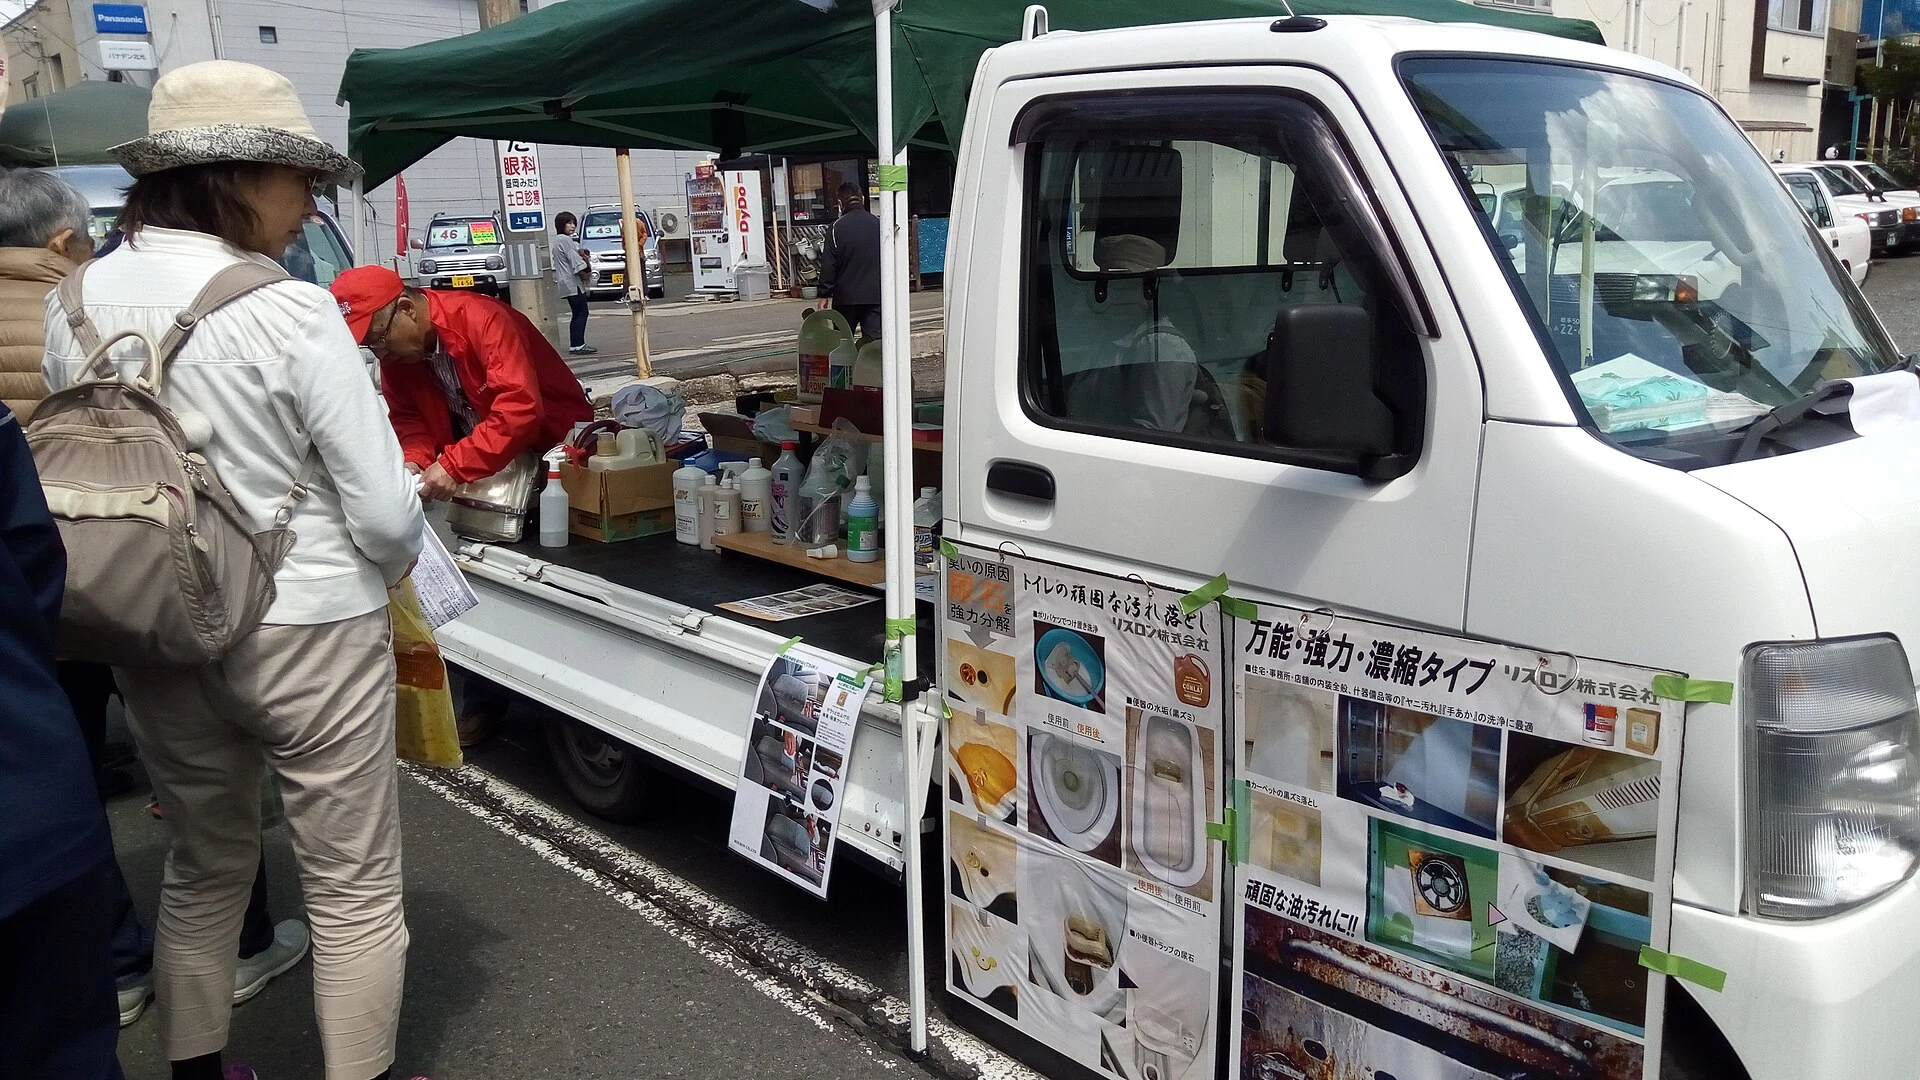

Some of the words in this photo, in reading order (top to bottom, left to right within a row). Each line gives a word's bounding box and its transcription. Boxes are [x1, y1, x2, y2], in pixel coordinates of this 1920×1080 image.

[98, 14, 143, 24] Panasonic
[504, 155, 537, 176] 眼科
[507, 189, 541, 207] 土日診療
[736, 186, 751, 233] DyDo
[440, 229, 458, 240] 46
[596, 227, 612, 235] 43
[1560, 323, 1580, 336] 22-
[950, 603, 1011, 632] 強力分解
[1023, 573, 1208, 635] トイレの頑固な汚れ落とし
[1112, 616, 1210, 652] リスロン株式会社
[1245, 619, 1497, 696] 万能・強力・濃縮タイプ
[1504, 664, 1660, 706] リスロン株式会社
[1047, 712, 1069, 728] 使用前
[1076, 723, 1101, 739] 使用後
[1250, 781, 1318, 808] カーペットの黒ズミ落とし
[1138, 879, 1163, 897] 使用後
[1174, 893, 1201, 912] 使用前
[1244, 879, 1359, 938] 頑固な油汚れに!!
[1136, 931, 1195, 963] 小便器トラップの尿石
